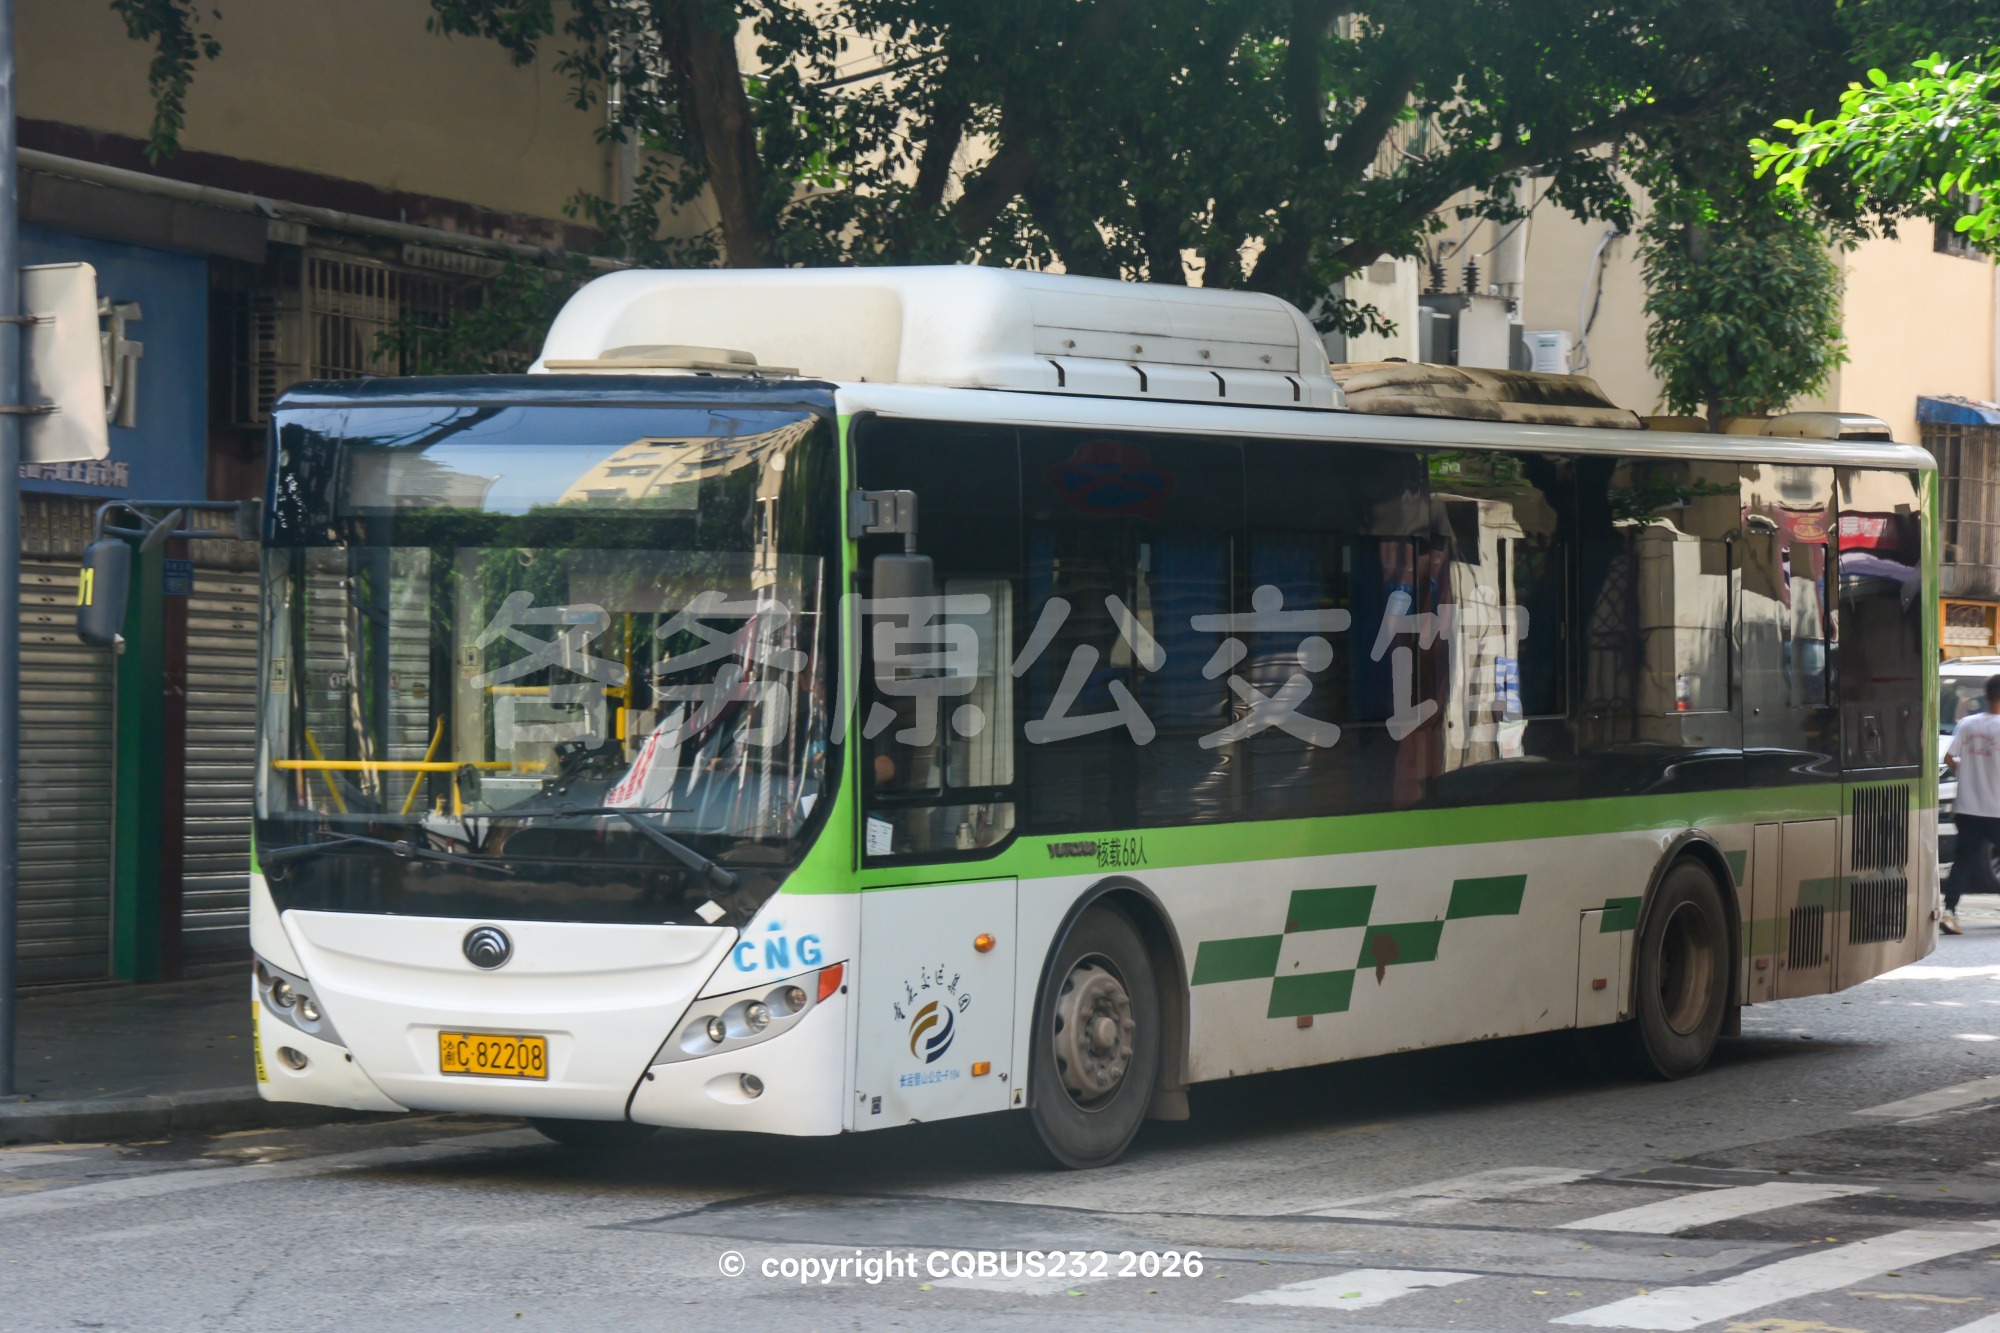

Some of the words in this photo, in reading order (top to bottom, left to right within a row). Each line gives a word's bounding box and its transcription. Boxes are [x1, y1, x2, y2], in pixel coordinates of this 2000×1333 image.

[1097, 836, 1148, 868] 核载68人
[733, 934, 823, 972] CNG
